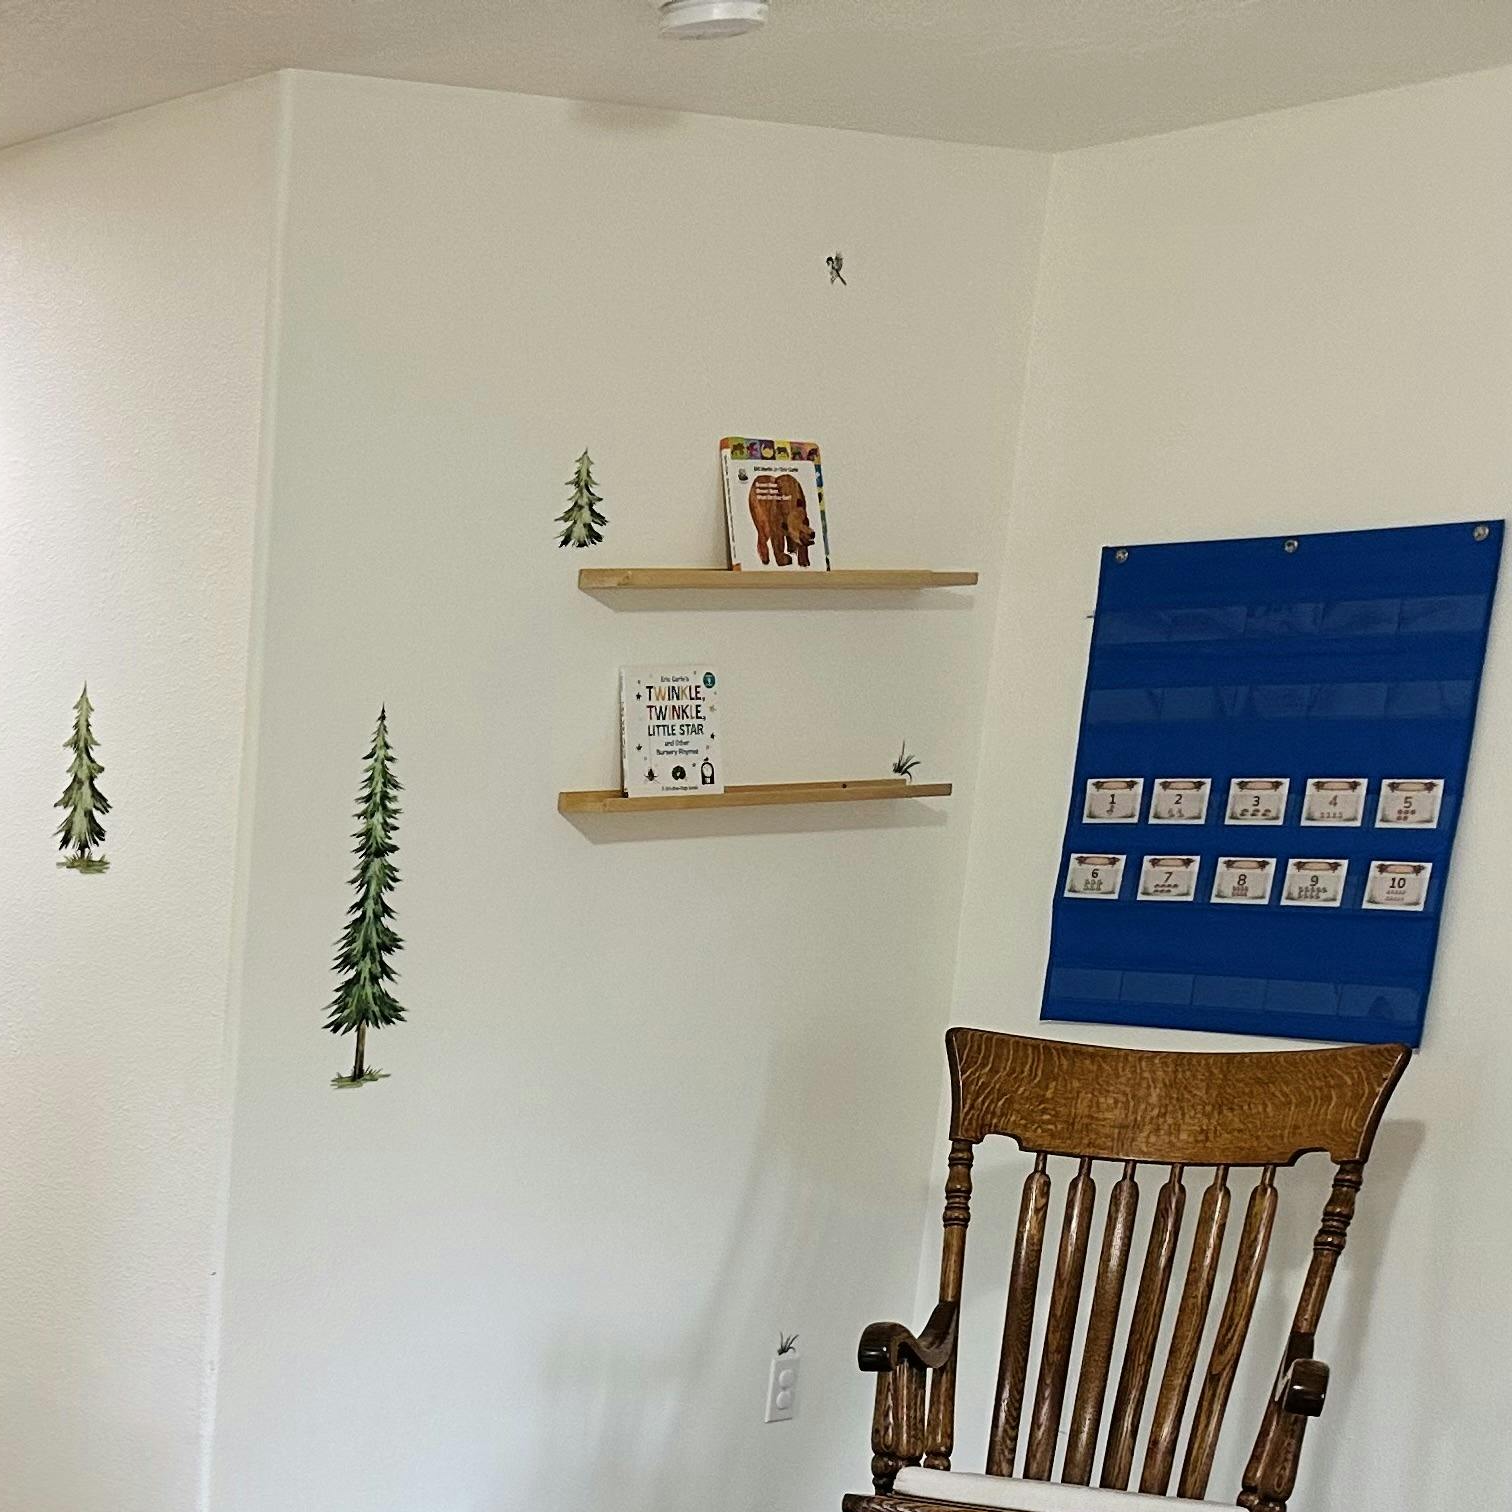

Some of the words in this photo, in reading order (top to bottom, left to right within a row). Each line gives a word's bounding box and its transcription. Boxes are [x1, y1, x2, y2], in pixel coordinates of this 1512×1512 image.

[646, 685, 706, 702] TWINKLE,
[646, 704, 706, 721] TWINKLE,
[648, 724, 676, 736] LITTLE
[679, 724, 704, 736] STAR
[1110, 794, 1116, 805] 1
[1174, 794, 1183, 805] 2
[1252, 796, 1260, 807] 3
[1328, 795, 1338, 807] 4
[1403, 796, 1413, 809] 5
[1091, 868, 1099, 879] 6
[1164, 872, 1173, 883] 7
[1237, 874, 1247, 886] 8
[1310, 875, 1319, 887] 9
[1389, 877, 1406, 889] 10
